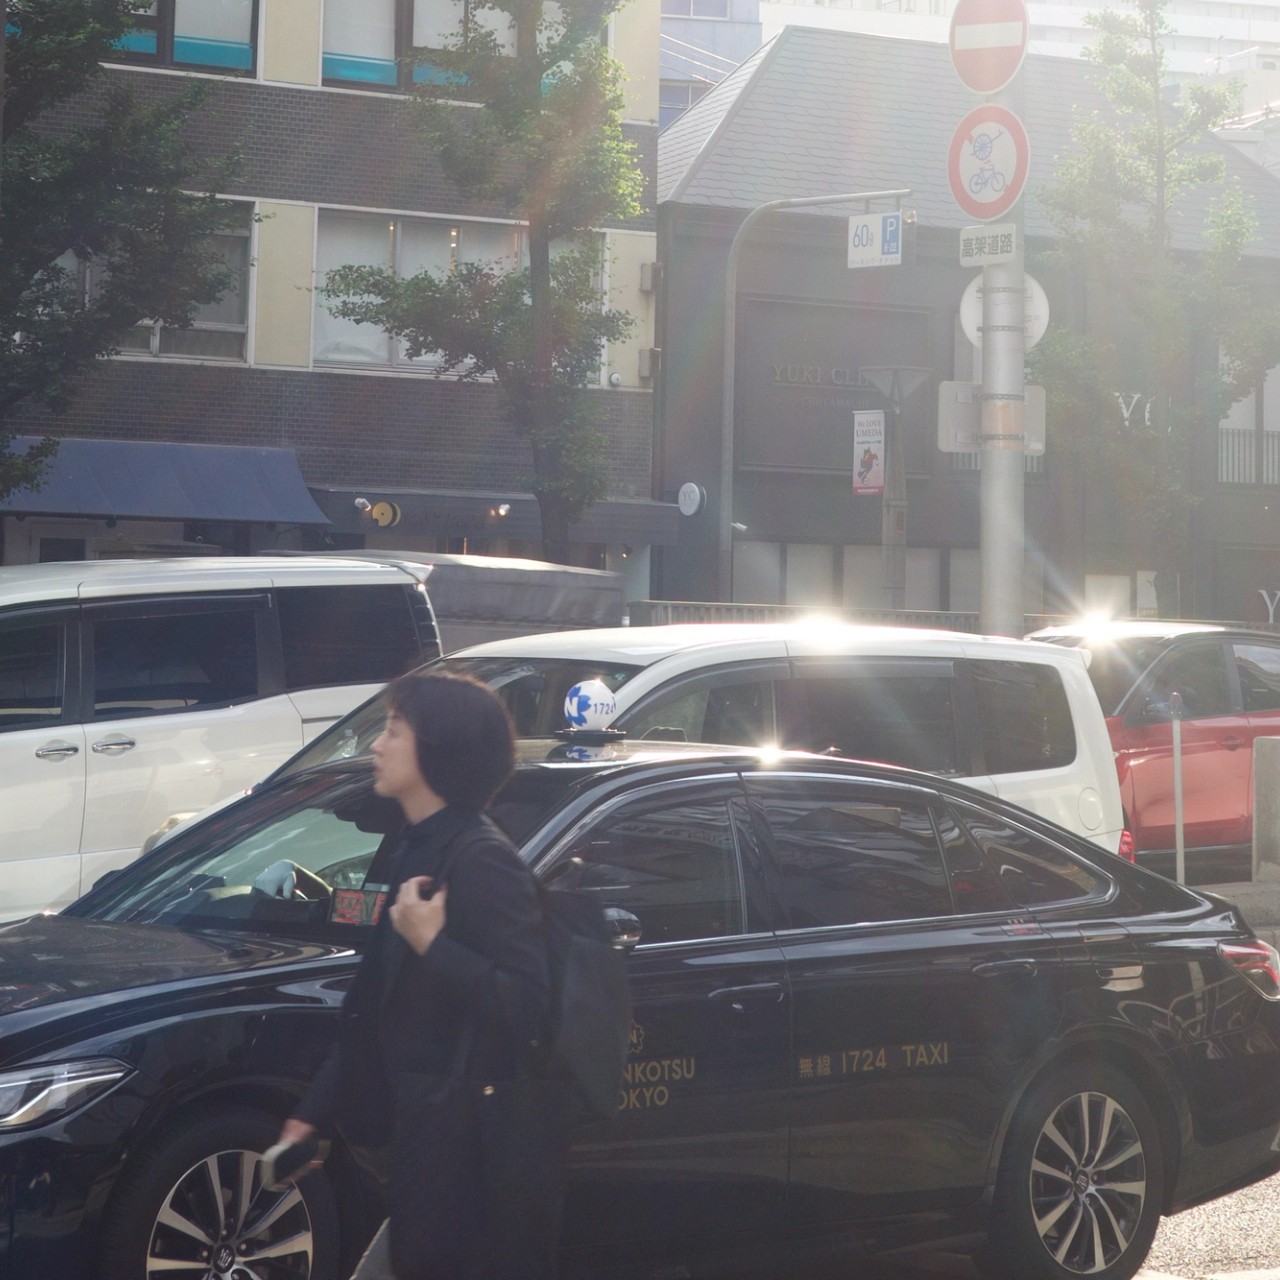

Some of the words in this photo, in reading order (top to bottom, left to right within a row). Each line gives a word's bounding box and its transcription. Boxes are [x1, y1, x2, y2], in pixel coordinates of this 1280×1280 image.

[887, 218, 896, 240] P
[961, 233, 1013, 258] 高架道路
[771, 364, 822, 383] YUKI
[856, 428, 882, 438] UMEDA
[593, 702, 614, 715] 1724
[624, 1058, 695, 1083] NKOTSU
[799, 1055, 831, 1078] 無線
[842, 1048, 887, 1073] 1724
[902, 1043, 949, 1067] TAXI
[619, 1086, 669, 1110] OKYO
